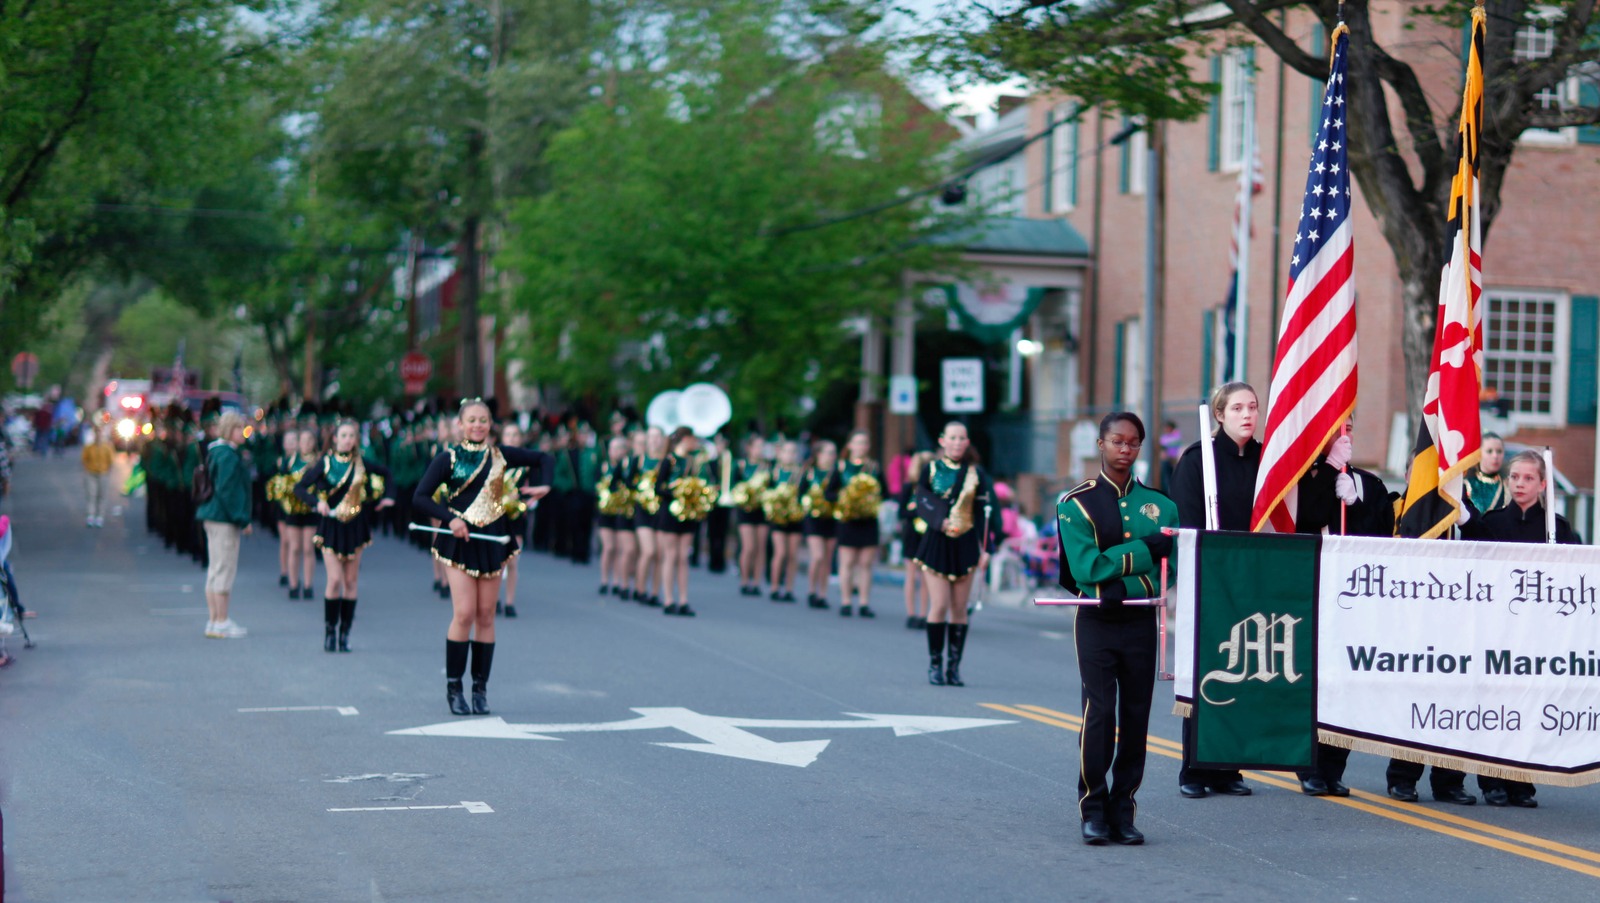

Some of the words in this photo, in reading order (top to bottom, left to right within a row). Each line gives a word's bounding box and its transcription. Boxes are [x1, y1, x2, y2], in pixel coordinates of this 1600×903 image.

[1337, 563, 1494, 610] Mardela
[1508, 568, 1598, 617] High
[1200, 611, 1302, 705] M
[1346, 645, 1472, 675] Warrior
[1485, 649, 1600, 677] Marchi
[1411, 702, 1521, 732] Mardela
